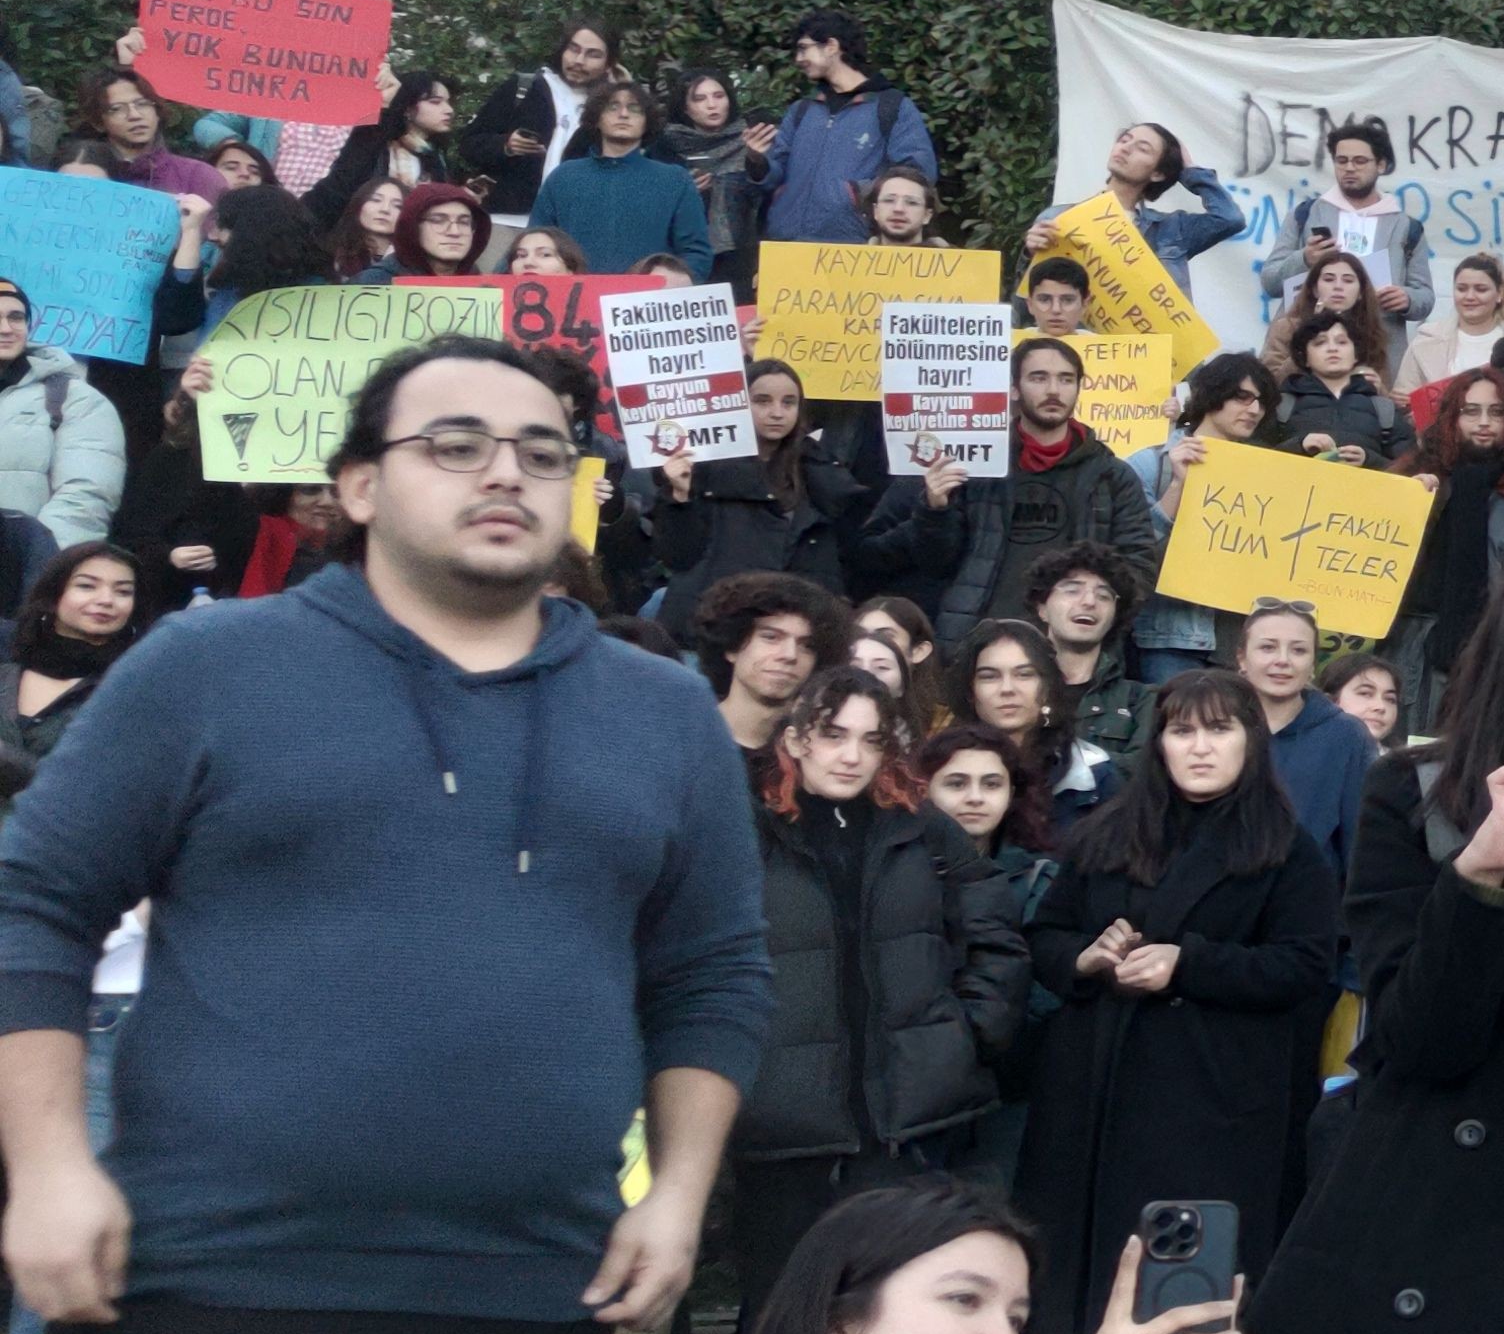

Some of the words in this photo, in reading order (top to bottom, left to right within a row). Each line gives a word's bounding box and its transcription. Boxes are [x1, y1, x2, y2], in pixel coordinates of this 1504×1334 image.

[297, 0, 354, 25] SON
[163, 28, 223, 60] YOK
[242, 43, 369, 79] BUNDAN
[206, 66, 310, 102] SONRA
[813, 247, 962, 278] KAYYUMUN
[1093, 202, 1144, 266] YÜRÜ
[1149, 283, 1192, 328] BRE
[611, 296, 728, 328] Fakültelerin
[609, 322, 738, 354] bölünmesine
[890, 315, 1004, 338] Fakültelerin
[648, 350, 706, 376] hayır!
[884, 338, 1009, 363] bölünmesine
[222, 353, 346, 401] OLAN
[646, 378, 711, 402] Kayyum
[917, 366, 973, 389] hayır!
[712, 390, 749, 411] son!
[912, 393, 974, 414] Kayyum
[971, 412, 1008, 430] son!
[687, 424, 738, 448] MFT
[943, 442, 993, 463] MFT
[1202, 483, 1273, 527] KAY
[1202, 516, 1269, 560] YUM
[1325, 513, 1410, 548] FAKÜL
[1316, 545, 1399, 583] TELER
